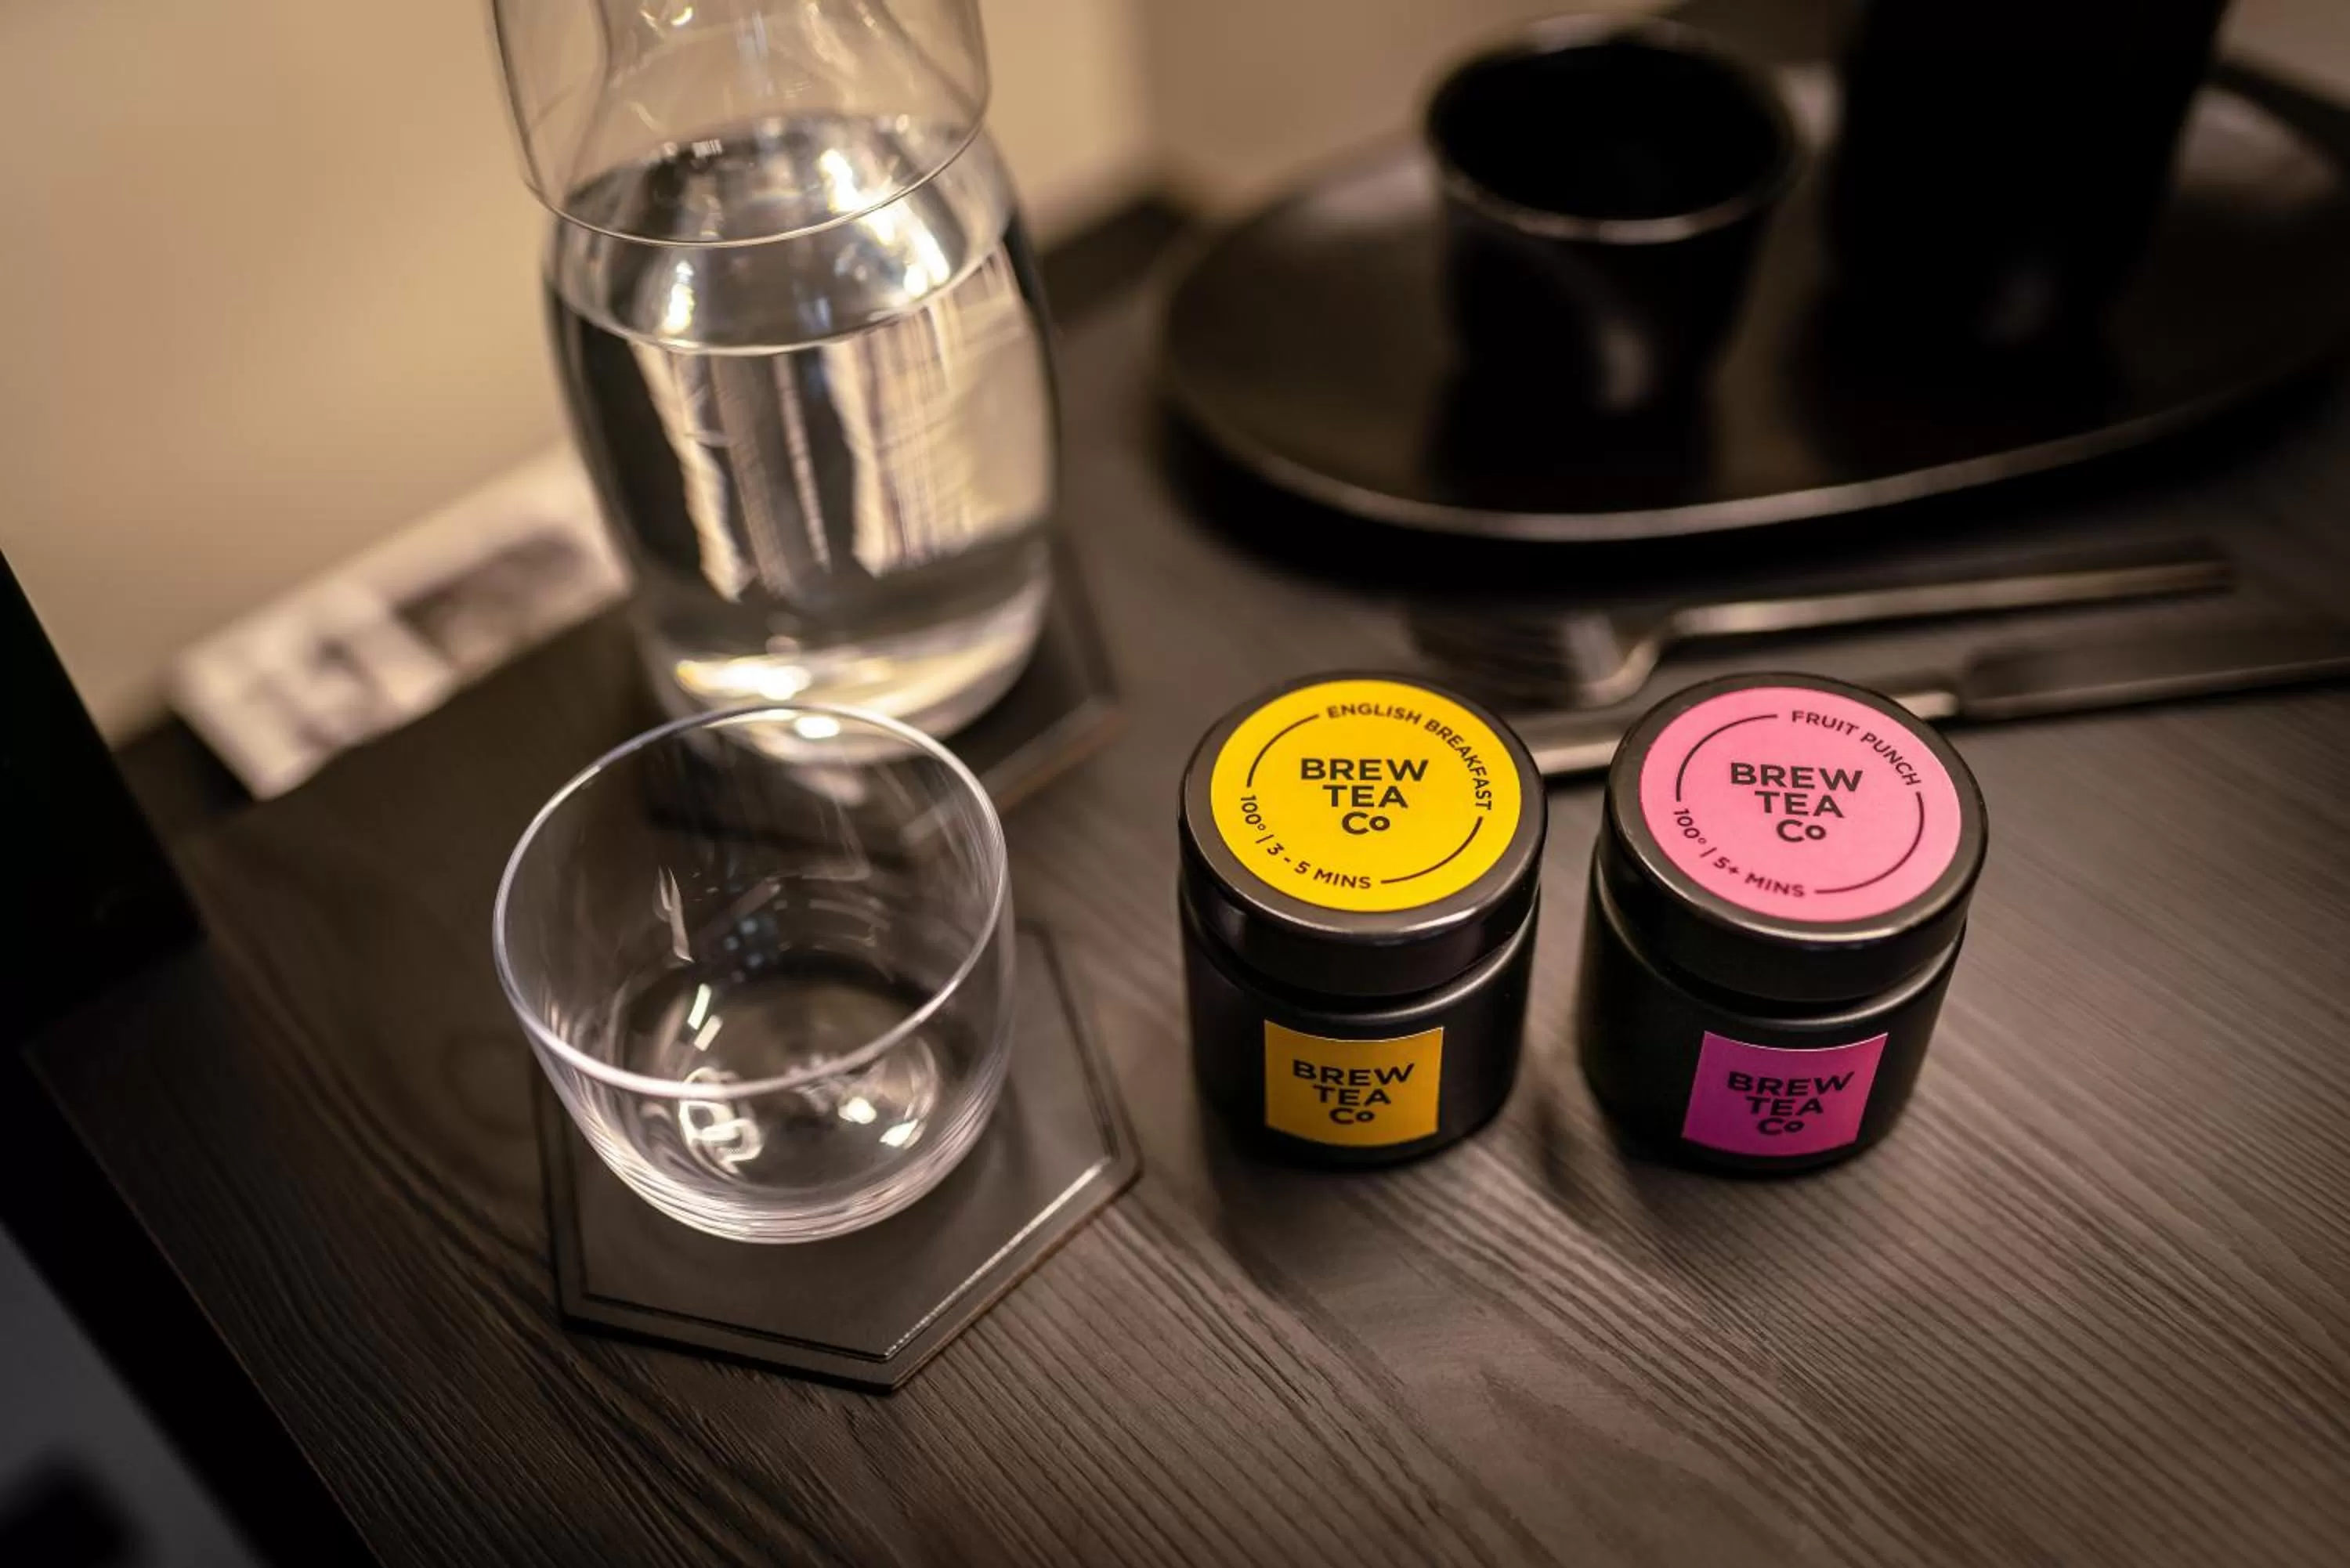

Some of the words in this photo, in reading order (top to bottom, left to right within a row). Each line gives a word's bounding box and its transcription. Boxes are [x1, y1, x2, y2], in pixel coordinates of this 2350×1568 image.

[1327, 703, 1422, 724] ENGLISH
[1424, 718, 1492, 811] BREAKFAST
[1791, 710, 1860, 736] FRUIT
[1860, 732, 1921, 786] PUNCH
[1300, 758, 1429, 782] BREW
[1730, 762, 1864, 791] BREW
[1322, 785, 1408, 808] TEA
[1755, 790, 1844, 818] TEA
[1267, 843, 1284, 857] 3
[1294, 861, 1310, 874] 5
[1313, 869, 1372, 890] MINS
[1713, 857, 1740, 875] 5+
[1744, 873, 1806, 898] MINS
[1292, 1059, 1415, 1086] BREW
[1727, 1071, 1855, 1097] BREW
[1312, 1085, 1391, 1107] TEA
[1745, 1096, 1824, 1116] TEA
